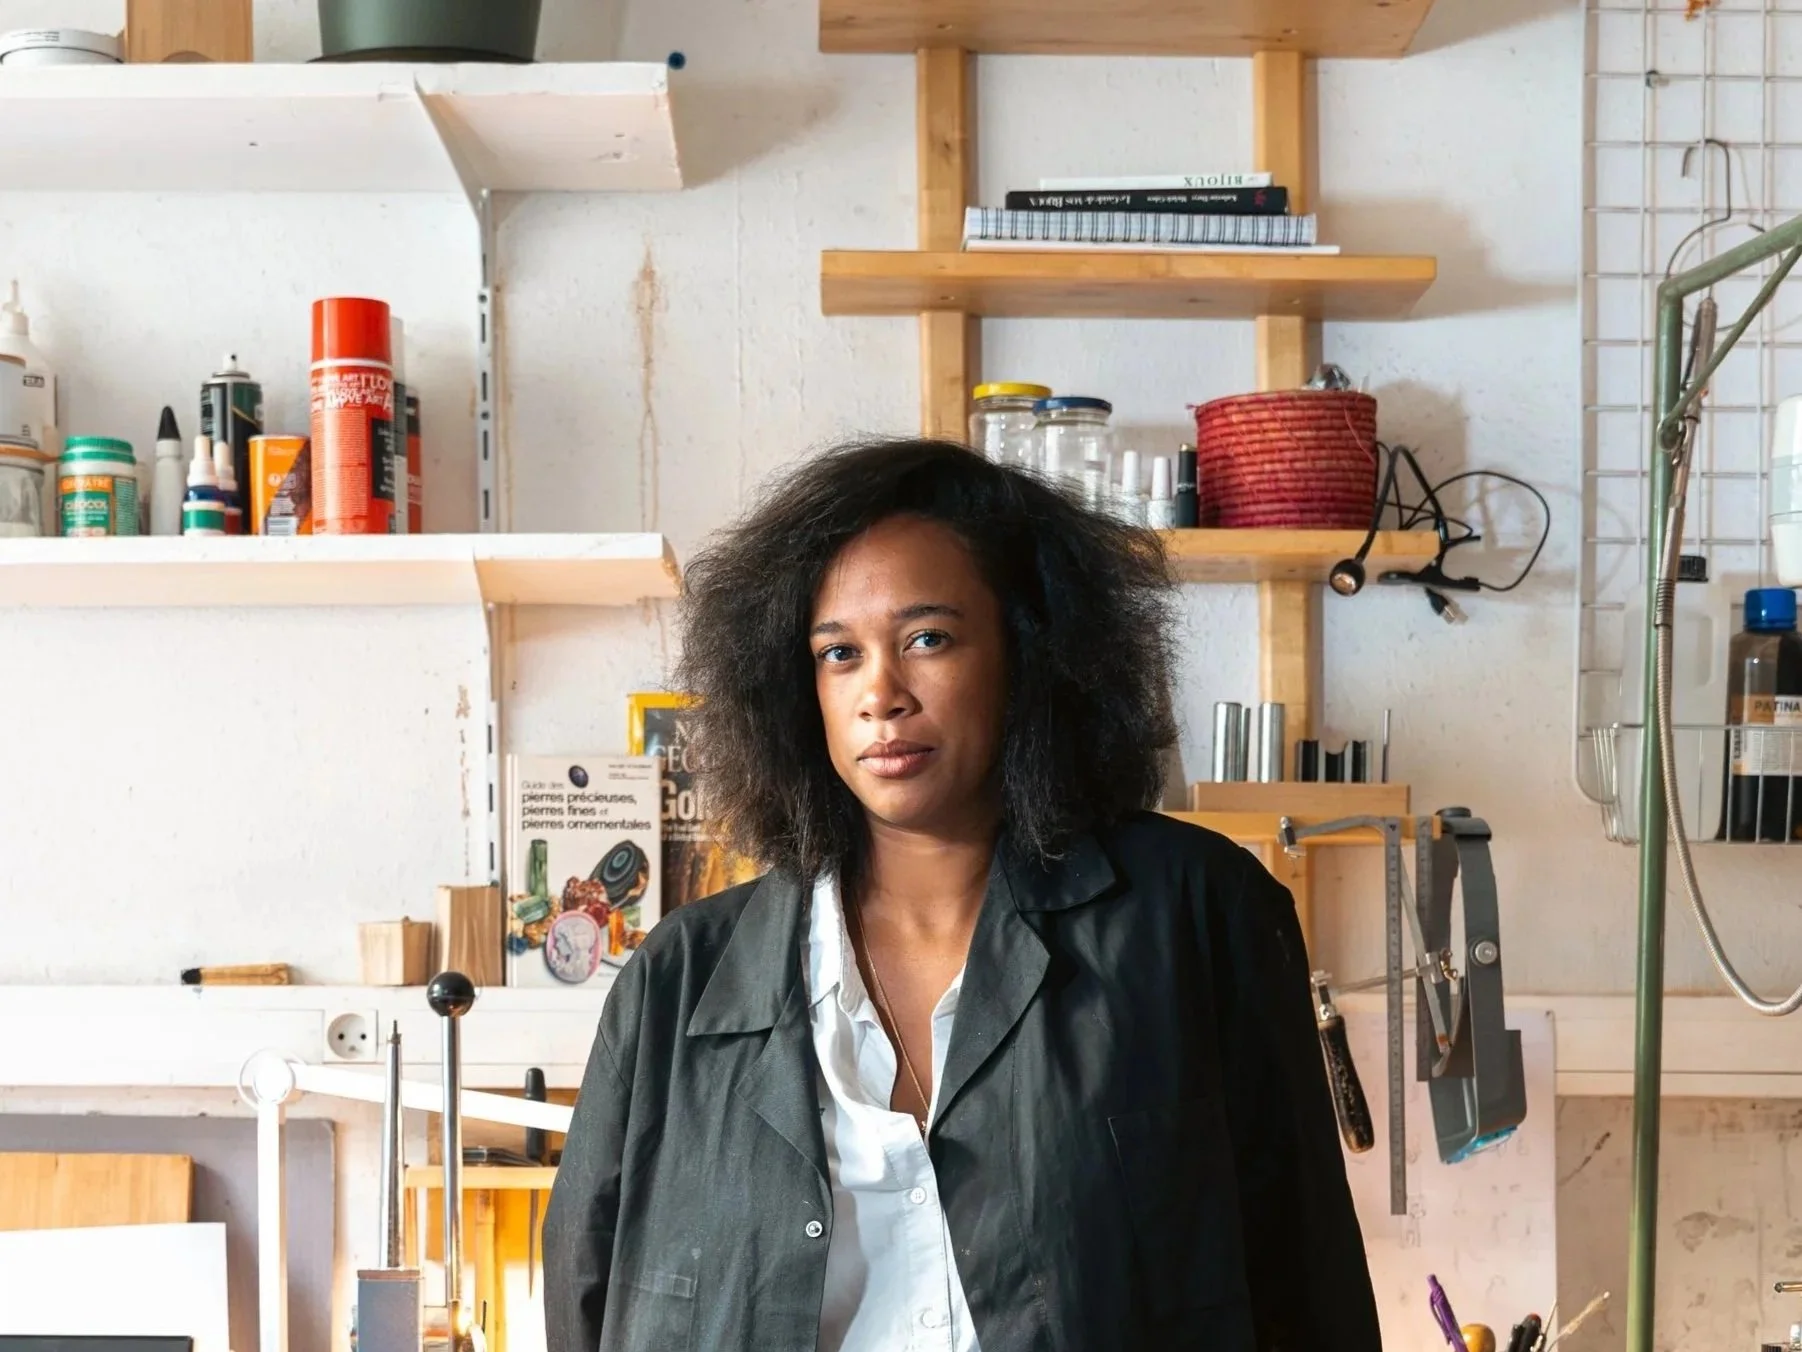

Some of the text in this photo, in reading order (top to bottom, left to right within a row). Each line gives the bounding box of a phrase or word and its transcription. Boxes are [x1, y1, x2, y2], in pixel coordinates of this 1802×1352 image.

[1184, 174, 1243, 187] BIJOUX
[1755, 701, 1801, 712] PATINA
[521, 780, 564, 790] Guide des
[521, 791, 637, 805] pierres précieuses,
[521, 805, 609, 817] pierres fines et
[521, 819, 564, 831] pierres
[567, 818, 652, 831] ornementales
